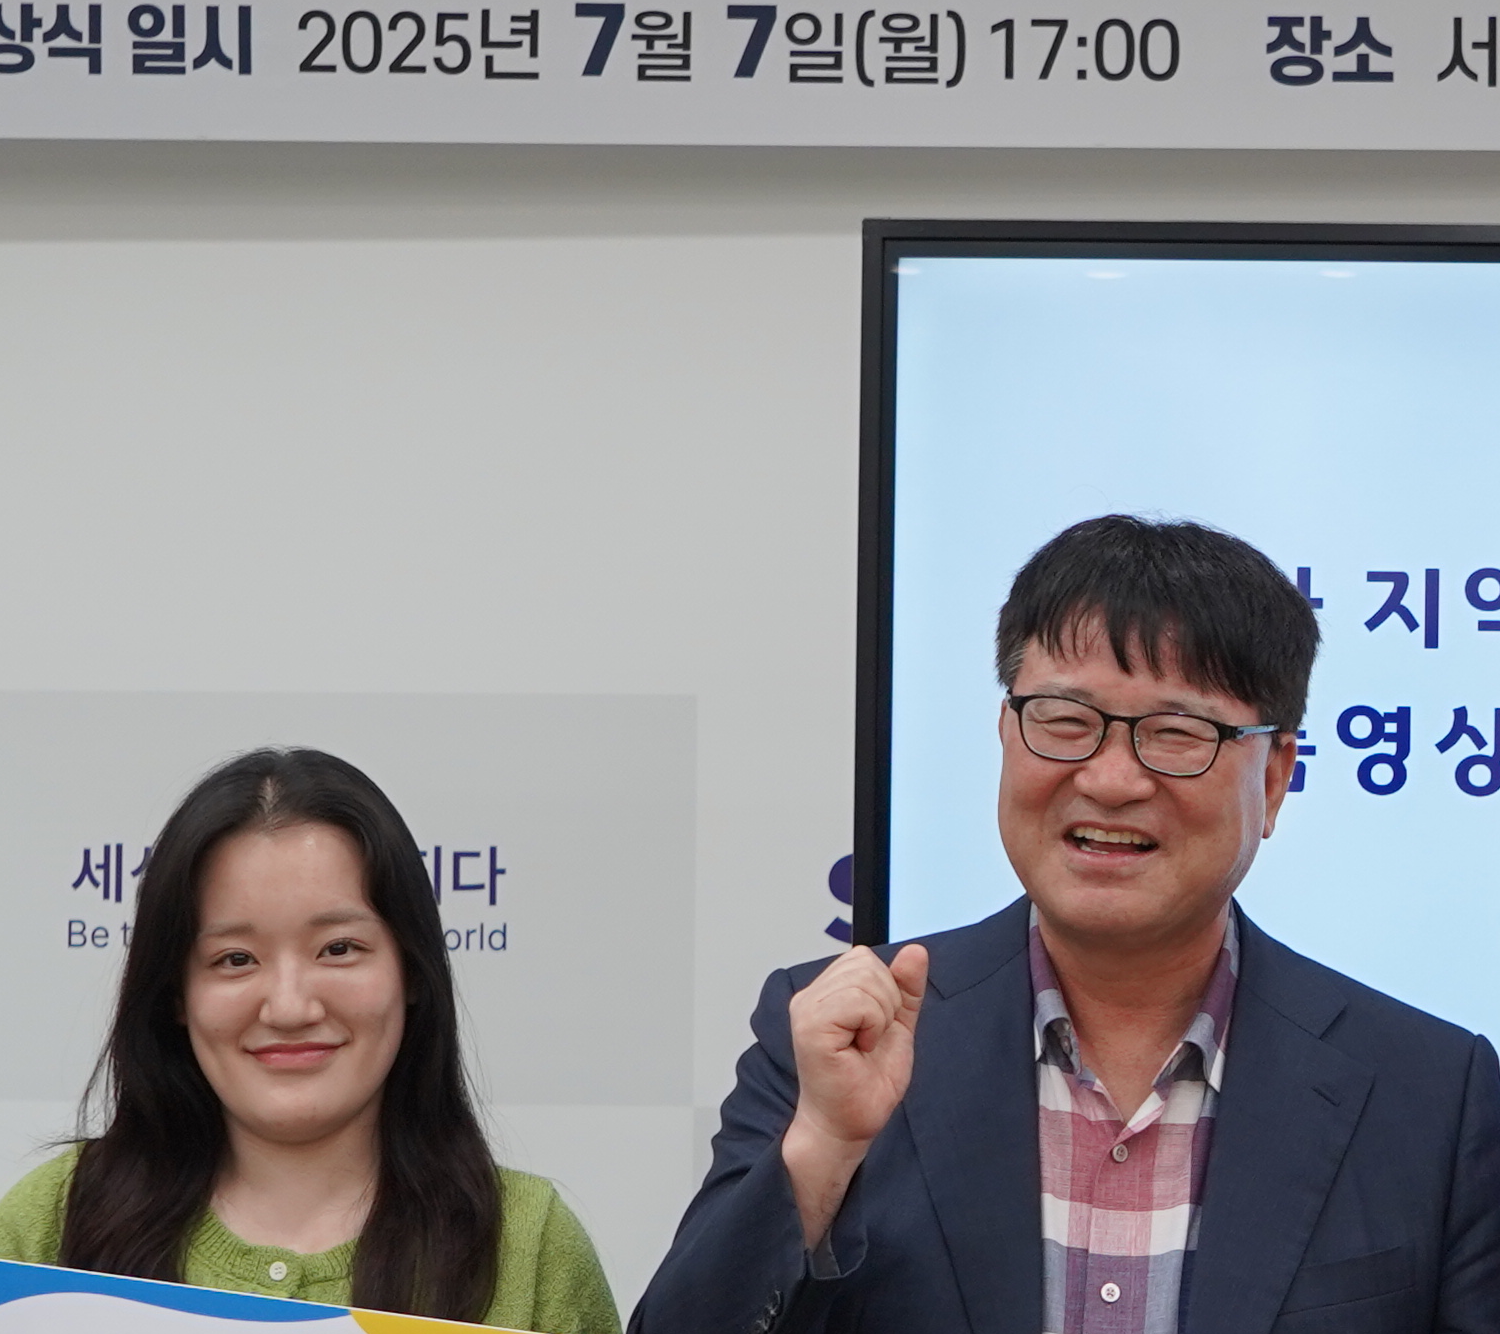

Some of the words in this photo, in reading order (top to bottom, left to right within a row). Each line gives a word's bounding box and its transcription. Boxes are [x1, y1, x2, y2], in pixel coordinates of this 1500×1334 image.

[127, 3, 252, 76] 일시
[297, 8, 540, 80] 2025년
[574, 2, 692, 82] 7월
[726, 4, 967, 89] 7일(월)
[990, 18, 1180, 82] 17:00
[1265, 15, 1394, 87] 장소
[67, 918, 110, 949] Be
[444, 922, 508, 952] orld
